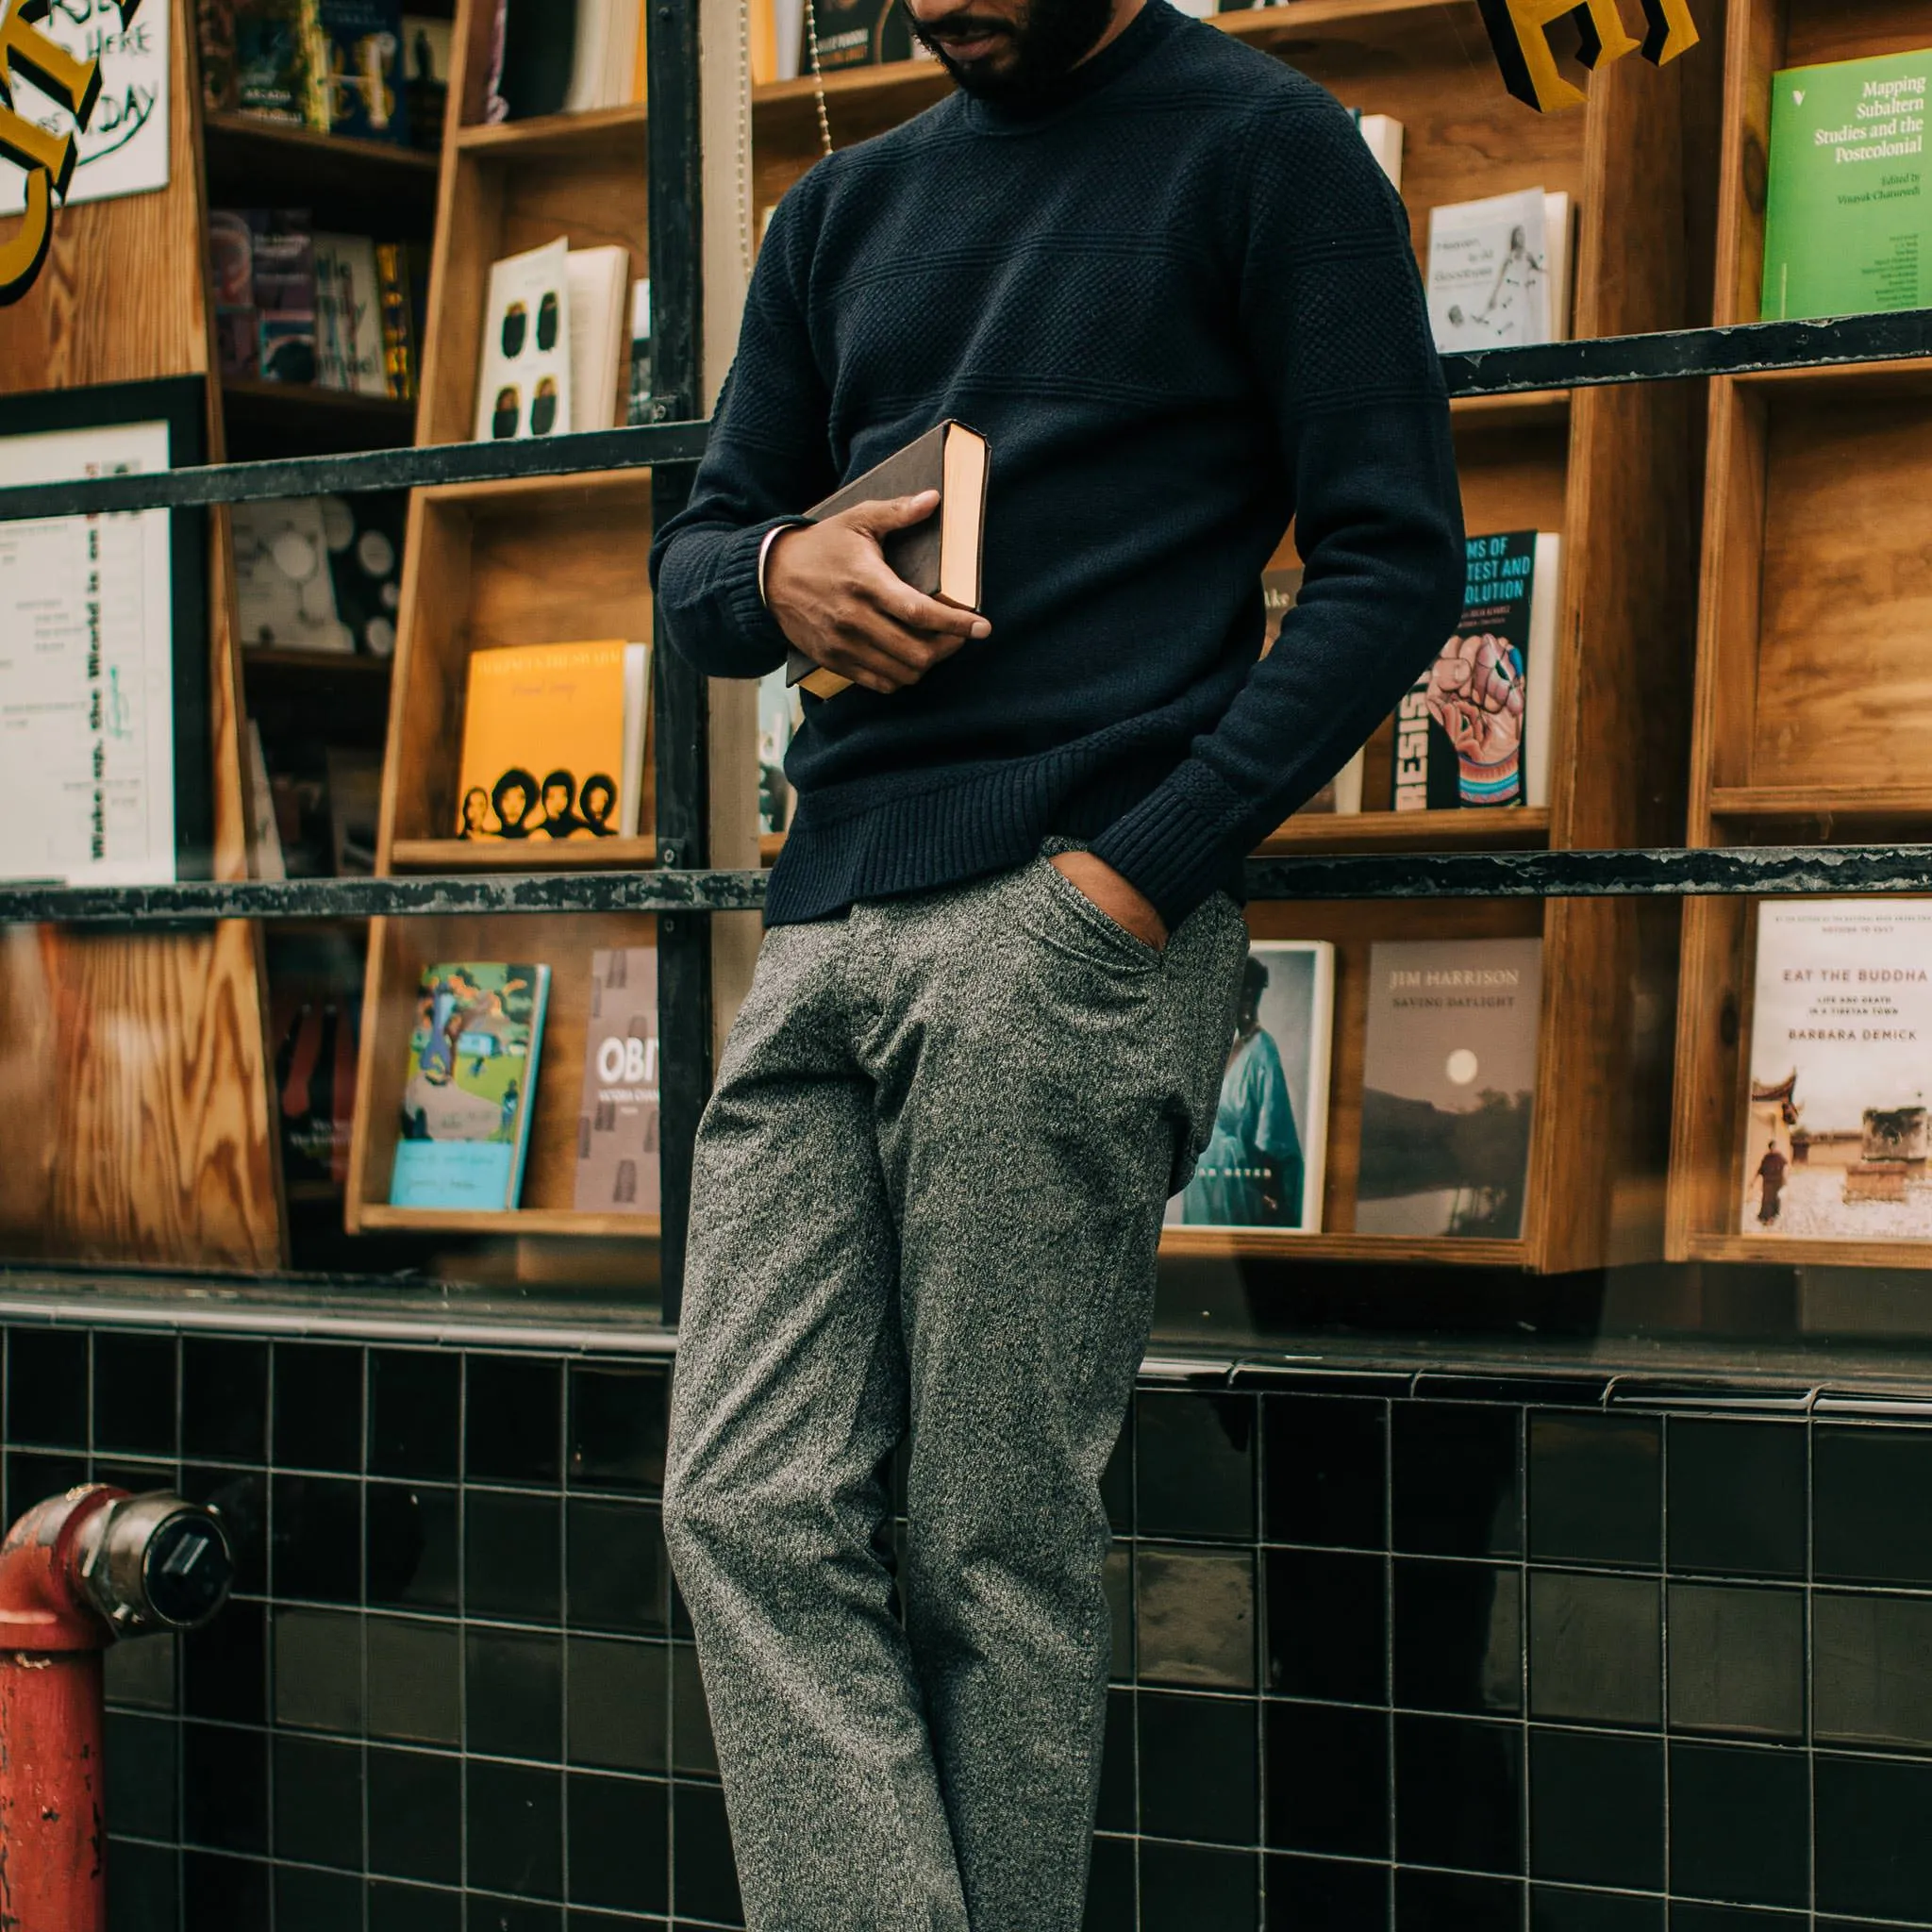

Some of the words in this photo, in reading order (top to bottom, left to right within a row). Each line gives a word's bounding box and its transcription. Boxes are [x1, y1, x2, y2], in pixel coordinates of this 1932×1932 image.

[1862, 75, 1926, 98] Mapping
[99, 79, 158, 133] DAY
[1857, 97, 1924, 119] Subaltern
[1814, 125, 1867, 146] Studies
[1869, 117, 1897, 138] and
[1900, 115, 1924, 133] the
[1835, 134, 1923, 164] Postcolonial
[1490, 536, 1508, 558] OF
[1467, 559, 1498, 582] TEST
[1501, 556, 1531, 578] AND
[1464, 578, 1524, 604] OLUTION
[1389, 971, 1422, 989] JIM
[1426, 969, 1520, 987] HARRISON
[1783, 969, 1813, 982] EAT
[1821, 969, 1851, 982] THE
[1858, 969, 1928, 982] BUDDHA
[1788, 1029, 1857, 1041] BARBARA
[1861, 1028, 1918, 1041] DEMICK
[597, 1036, 659, 1084] OBI
